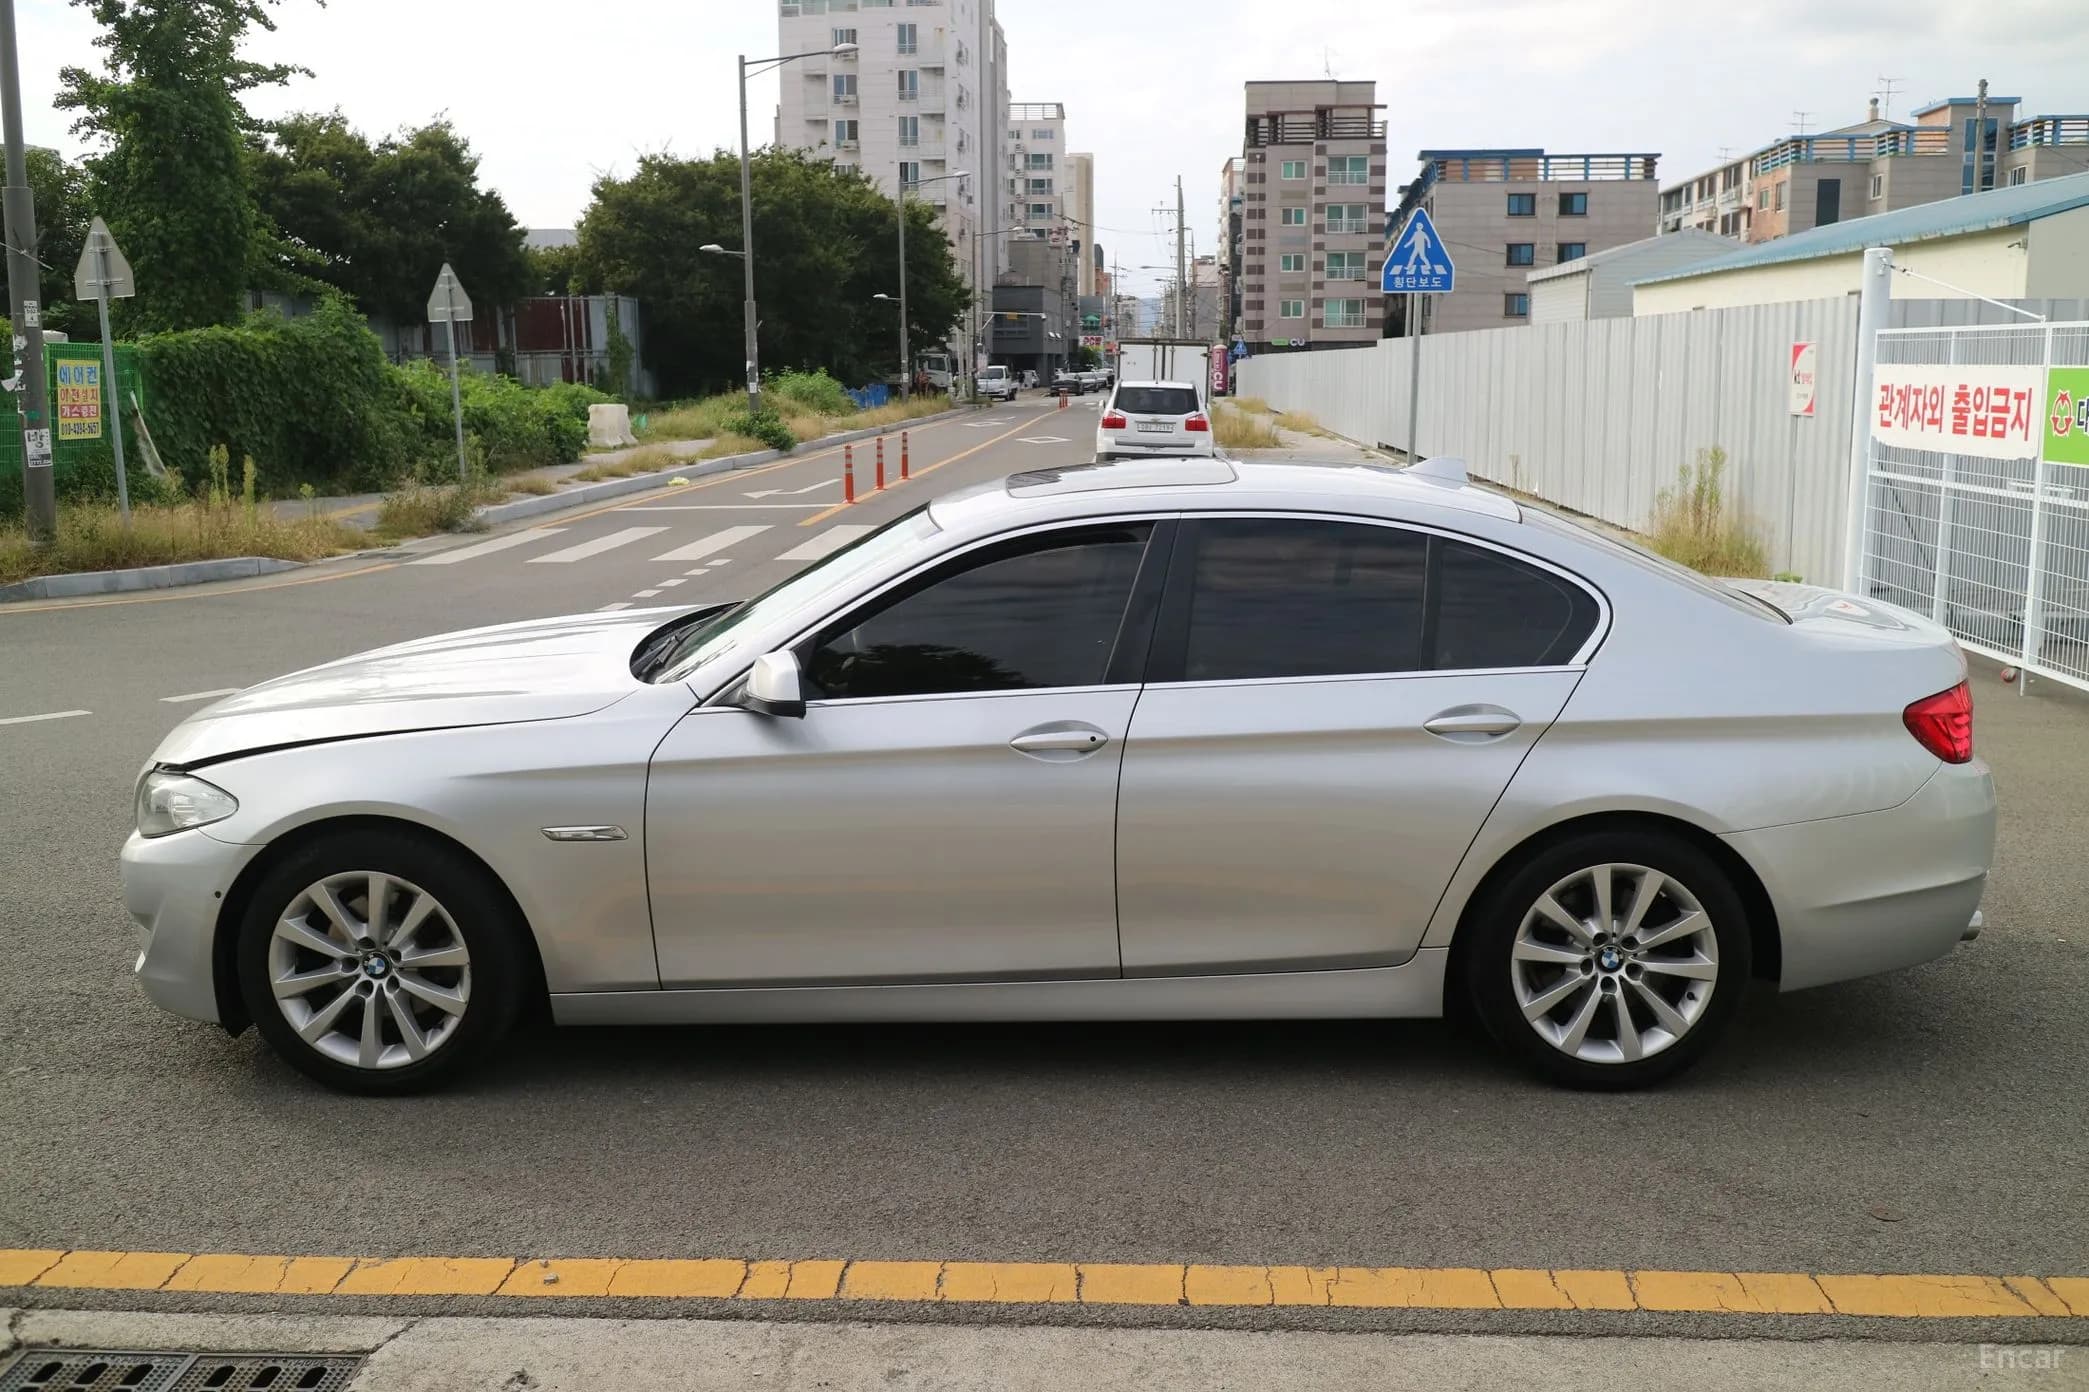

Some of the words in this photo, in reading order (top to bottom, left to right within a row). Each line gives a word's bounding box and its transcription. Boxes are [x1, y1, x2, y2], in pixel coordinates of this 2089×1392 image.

[1394, 276, 1442, 288] 횡단보도
[1290, 338, 1305, 346] CU
[60, 366, 97, 385] 에어컨
[62, 405, 97, 417] 가스충전
[1879, 383, 1945, 434] 관계자외
[1951, 384, 2032, 442] 출입금지
